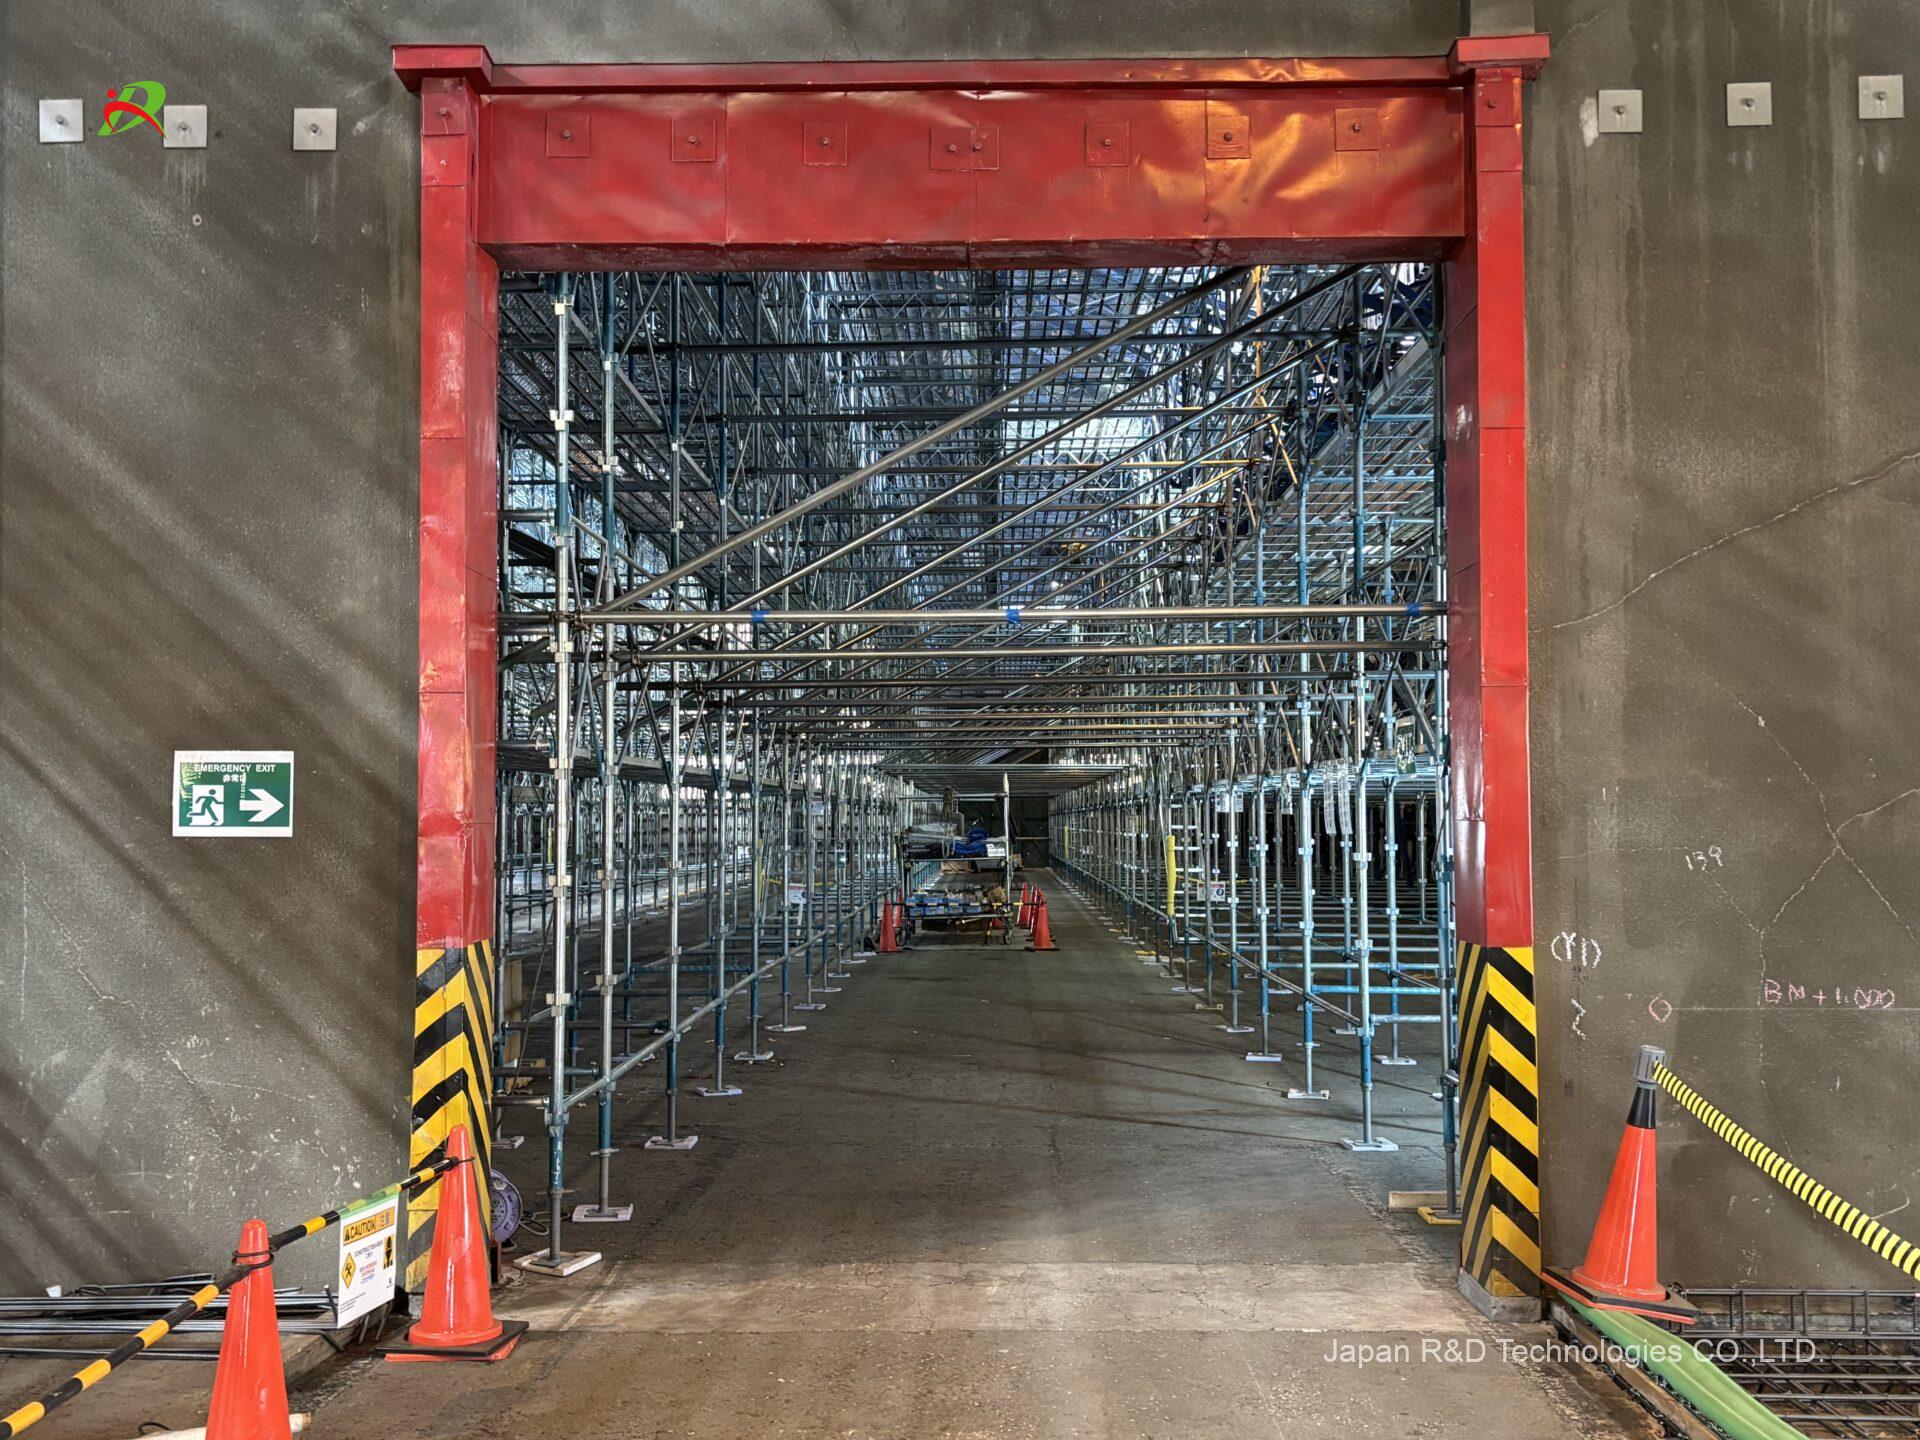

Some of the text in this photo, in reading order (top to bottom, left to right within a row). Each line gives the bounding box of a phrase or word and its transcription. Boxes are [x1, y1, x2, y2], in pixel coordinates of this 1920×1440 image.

[195, 764, 276, 772] EMERGENCY EXIT
[351, 1218, 375, 1238] CAUTION
